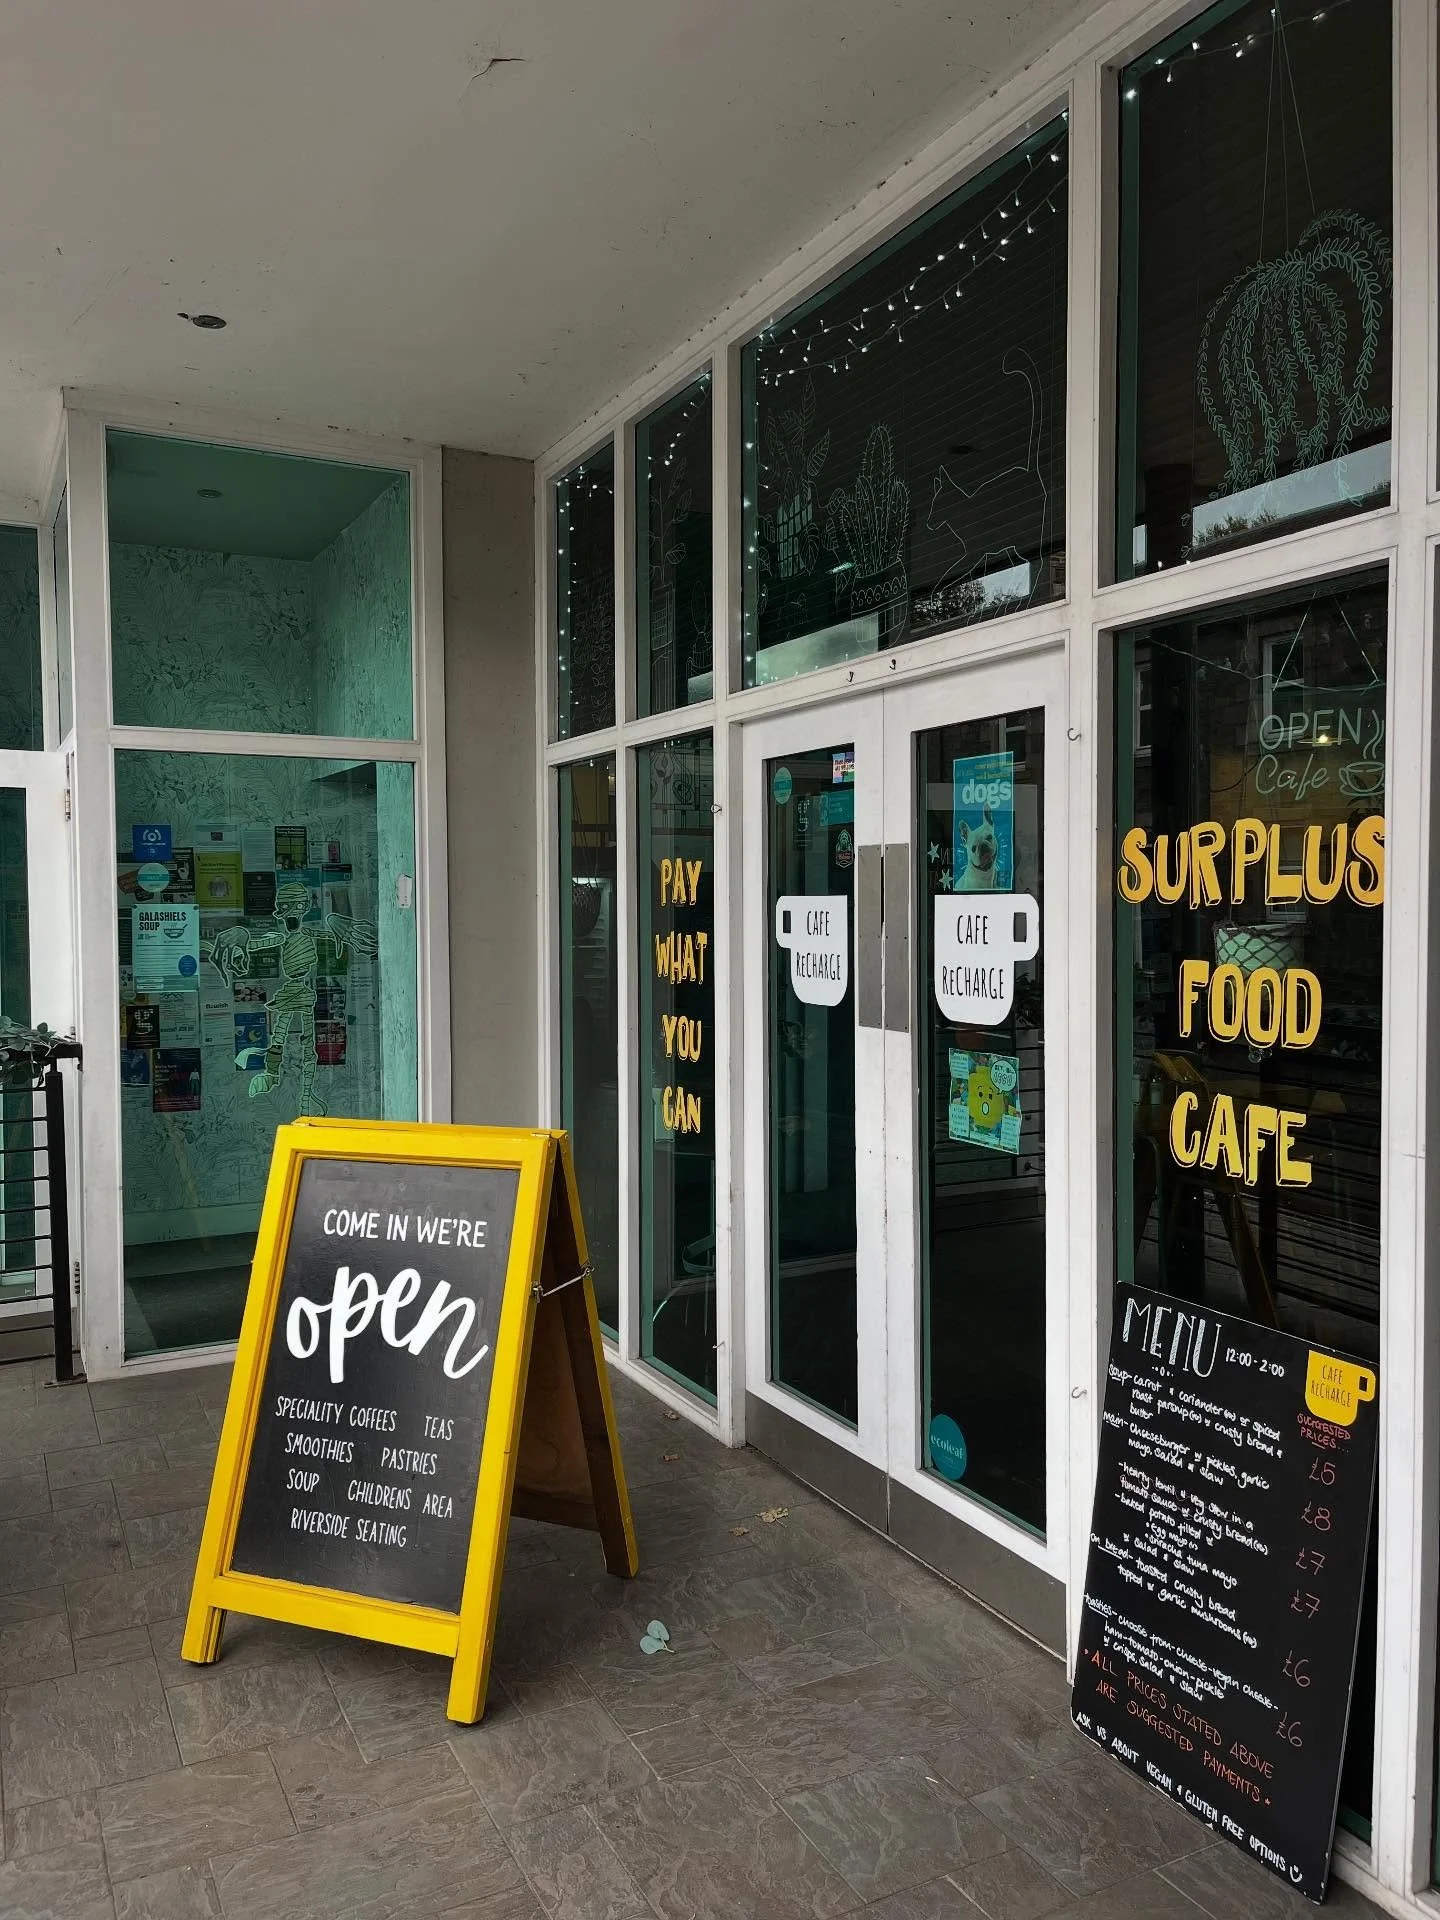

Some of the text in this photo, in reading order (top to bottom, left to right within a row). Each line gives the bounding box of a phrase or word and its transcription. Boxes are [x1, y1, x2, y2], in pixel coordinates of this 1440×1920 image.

[1260, 708, 1361, 750] OPEN
[962, 778, 1012, 809] dogs
[1256, 754, 1330, 800] Cafe
[660, 857, 703, 907] PAY
[1117, 815, 1386, 909] SURPLUS
[138, 911, 187, 922] GALASHIELS
[138, 922, 160, 932] SOUP
[806, 910, 830, 937] CAFE
[957, 914, 989, 945] CAFE
[655, 930, 707, 985] WHAT
[1179, 959, 1322, 1049] FOOD
[661, 1014, 702, 1062] YOU
[662, 1085, 701, 1134] CAN
[1169, 1091, 1312, 1187] CAFE
[323, 1208, 487, 1248] COME IN WE'RE
[286, 1266, 489, 1384] open
[1122, 1298, 1222, 1378] MENU
[1133, 1374, 1162, 1392] carrot
[1322, 1365, 1343, 1384] CAFE
[275, 1395, 454, 1441] SPECIALITY COFFEES TEAS
[1132, 1388, 1153, 1404] roast
[1214, 1422, 1242, 1447] crusty
[1246, 1433, 1274, 1457] bread
[285, 1432, 437, 1475] SMOOTHIES PASTRIES
[1309, 1457, 1336, 1486] £5
[286, 1468, 453, 1518] SOUP CHILDRENS AREA
[291, 1508, 407, 1547] RIVERSIDE SEATING
[1193, 1512, 1222, 1540] crusty
[1231, 1511, 1242, 1525] in
[1245, 1520, 1254, 1531] a
[1301, 1501, 1331, 1531] £8
[1186, 1554, 1209, 1573] tuna
[1211, 1568, 1238, 1590] mayo
[1295, 1547, 1326, 1576] £7
[1173, 1579, 1204, 1609] crusty
[1208, 1596, 1236, 1622] bread
[1291, 1589, 1321, 1619] £7
[1282, 1650, 1311, 1687] £6
[1095, 1680, 1261, 1803] ARE SUGGESTED PAYMENTS
[1127, 1670, 1167, 1709] PRICES
[1173, 1703, 1222, 1746] STATED
[1229, 1741, 1275, 1779] ABOVE
[1276, 1712, 1303, 1747] £6
[1076, 1711, 1092, 1730] ASK
[1111, 1737, 1140, 1763] ABOUT
[1146, 1760, 1172, 1792] VEGAN
[1185, 1789, 1218, 1823] GLUTEN
[1221, 1814, 1245, 1840] FREE
[1249, 1834, 1287, 1872] OPTIONS
